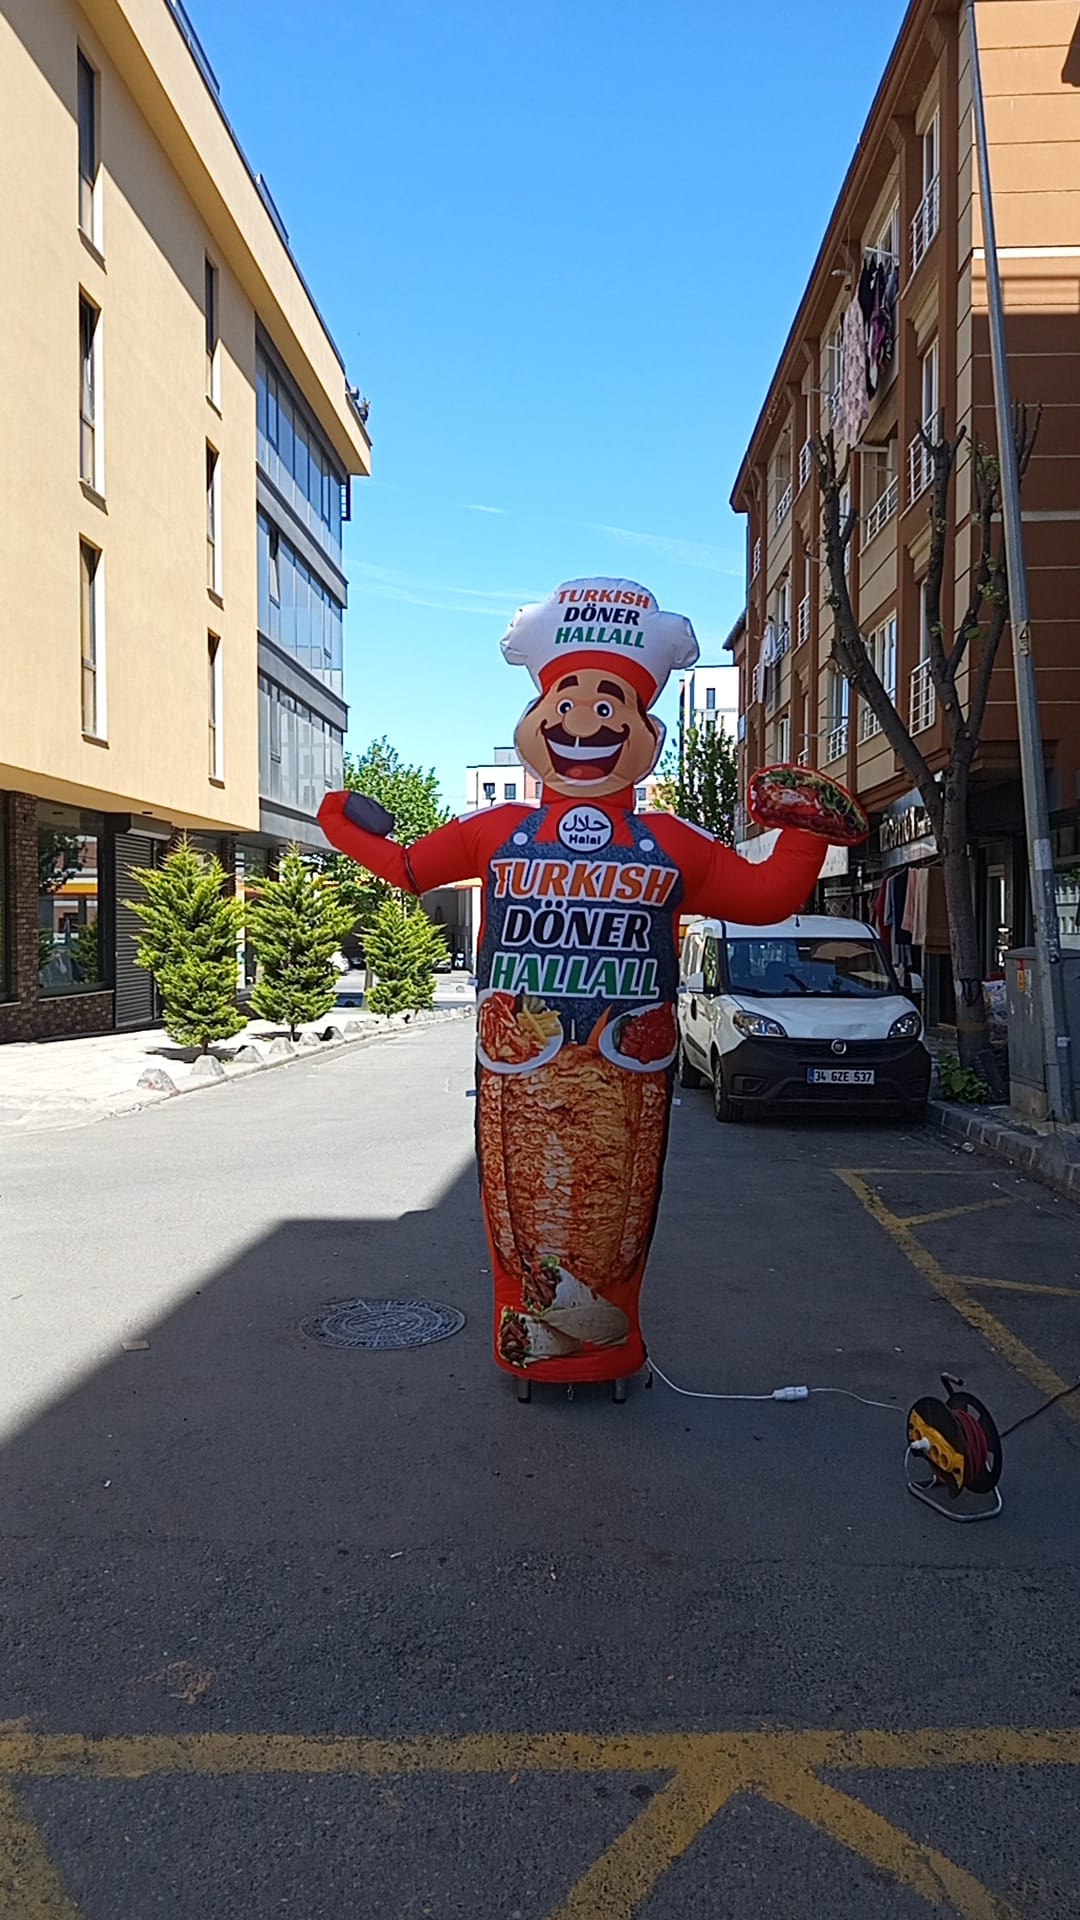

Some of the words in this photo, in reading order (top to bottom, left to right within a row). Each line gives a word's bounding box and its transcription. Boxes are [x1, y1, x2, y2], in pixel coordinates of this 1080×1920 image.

[558, 589, 650, 609] TURKISH
[563, 603, 640, 626] DÖNER
[555, 626, 645, 648] HALLALL
[563, 814, 609, 832] حلال
[569, 834, 601, 845] Halal
[491, 859, 679, 907] TURKISH
[502, 900, 651, 952] DÖNER
[490, 952, 660, 998] HALLALL
[815, 1071, 826, 1082] 34
[831, 1071, 849, 1082] GZE
[854, 1072, 872, 1082] 537
